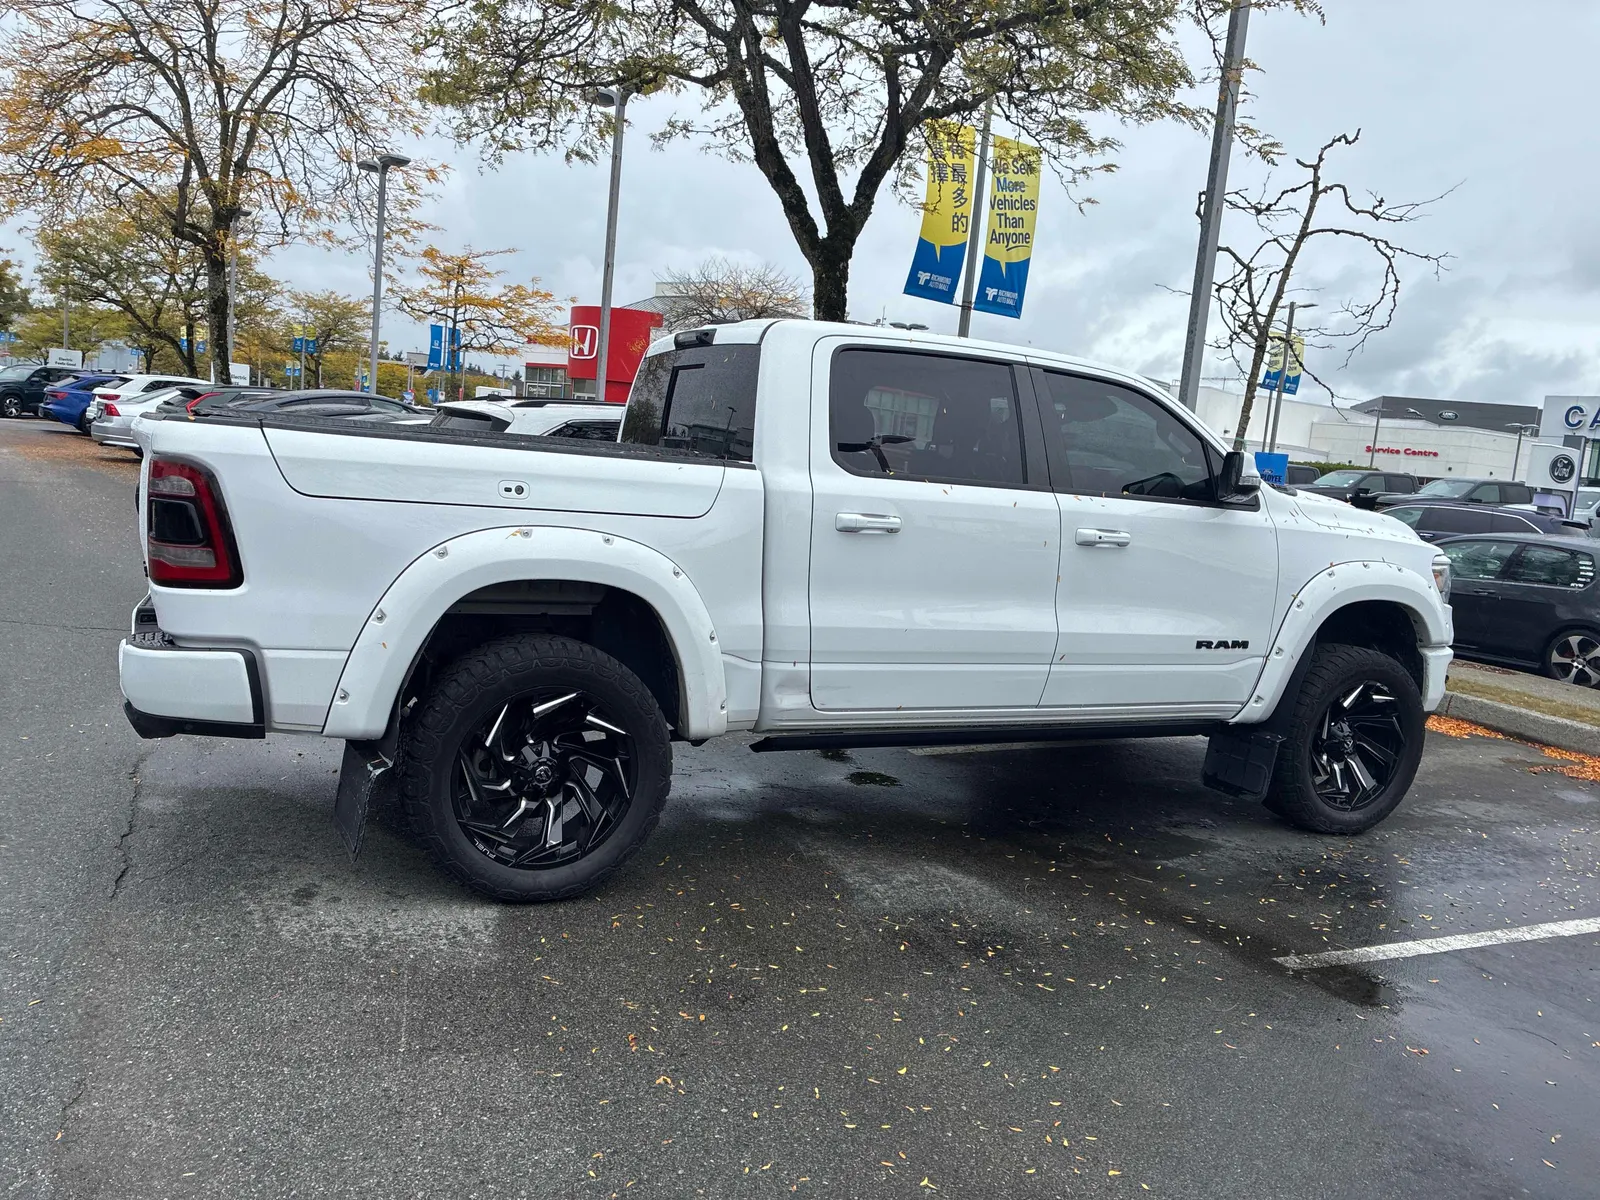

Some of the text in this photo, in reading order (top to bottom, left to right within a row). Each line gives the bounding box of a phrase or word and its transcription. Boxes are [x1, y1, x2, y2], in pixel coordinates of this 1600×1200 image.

[992, 159, 1009, 174] We
[996, 177, 1026, 193] More
[990, 195, 1035, 210] Vehicles
[996, 212, 1024, 229] Than
[989, 229, 1031, 249] Anyone
[1403, 447, 1439, 457] Centre
[1554, 458, 1572, 478] Ford
[1195, 640, 1250, 650] RAM
[474, 837, 497, 859] FUEL
